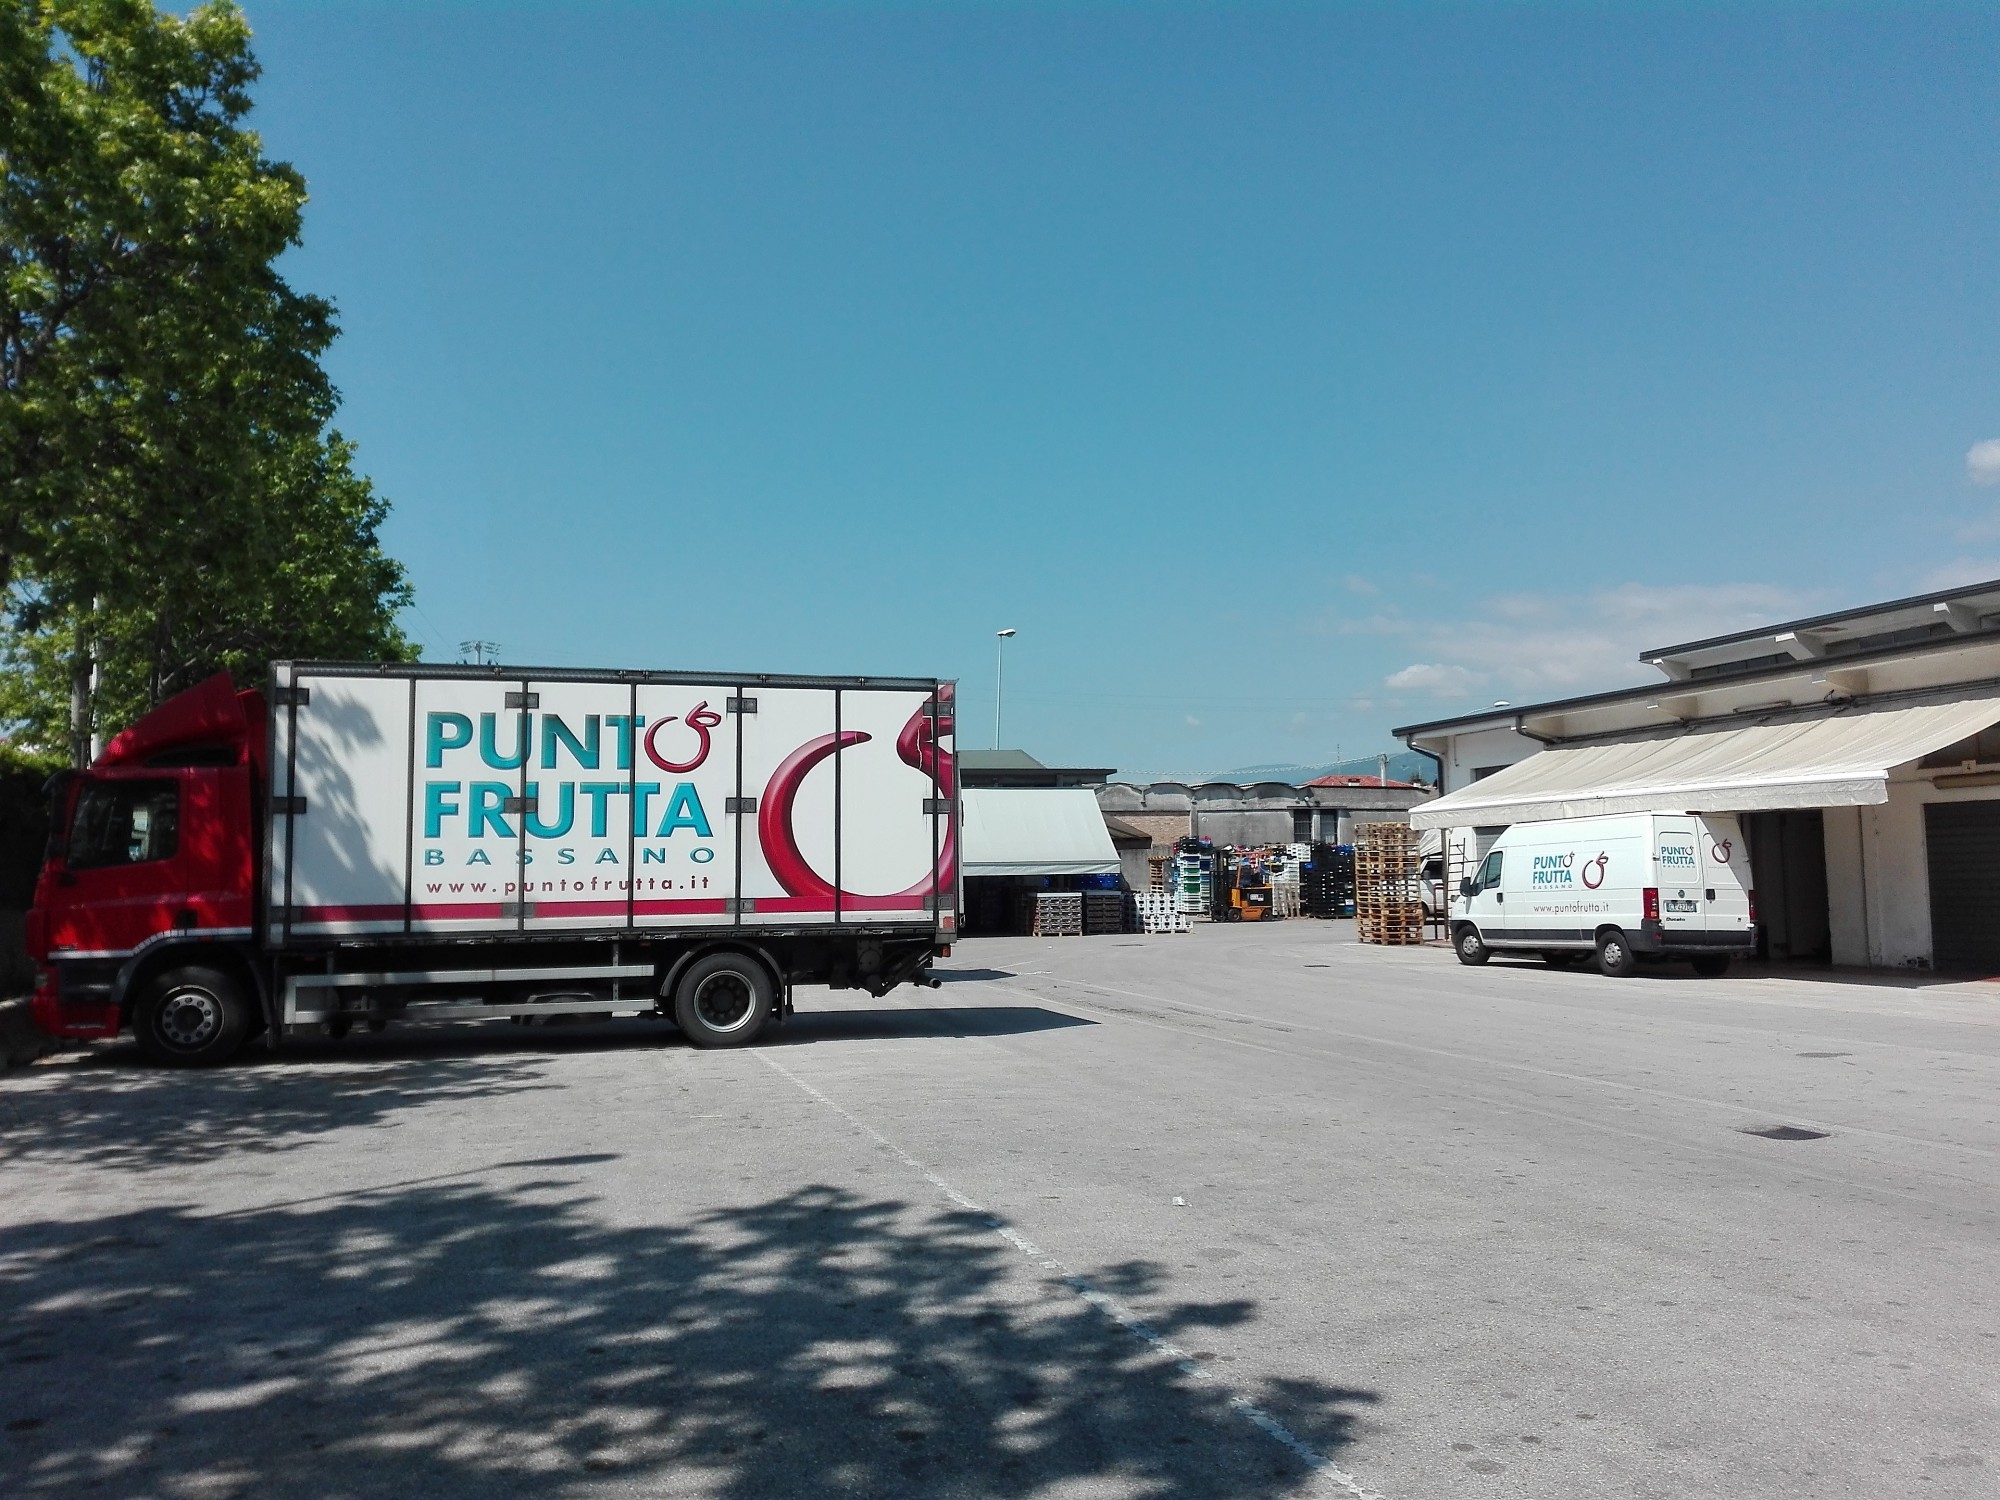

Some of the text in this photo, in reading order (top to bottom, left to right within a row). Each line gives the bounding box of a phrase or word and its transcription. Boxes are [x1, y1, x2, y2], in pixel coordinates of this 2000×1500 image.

[425, 701, 722, 774] PUNTO
[423, 780, 714, 839] FRUTTA
[424, 847, 715, 866] BASSANO
[1661, 845, 1694, 856] PUNTO
[1533, 851, 1575, 869] PUNTO
[1662, 855, 1695, 865] FRUTTA
[426, 875, 709, 895] www.puntofrutta.it
[1533, 869, 1572, 884] FRUTTA
[1533, 900, 1609, 915] www.puntofrutta.it
